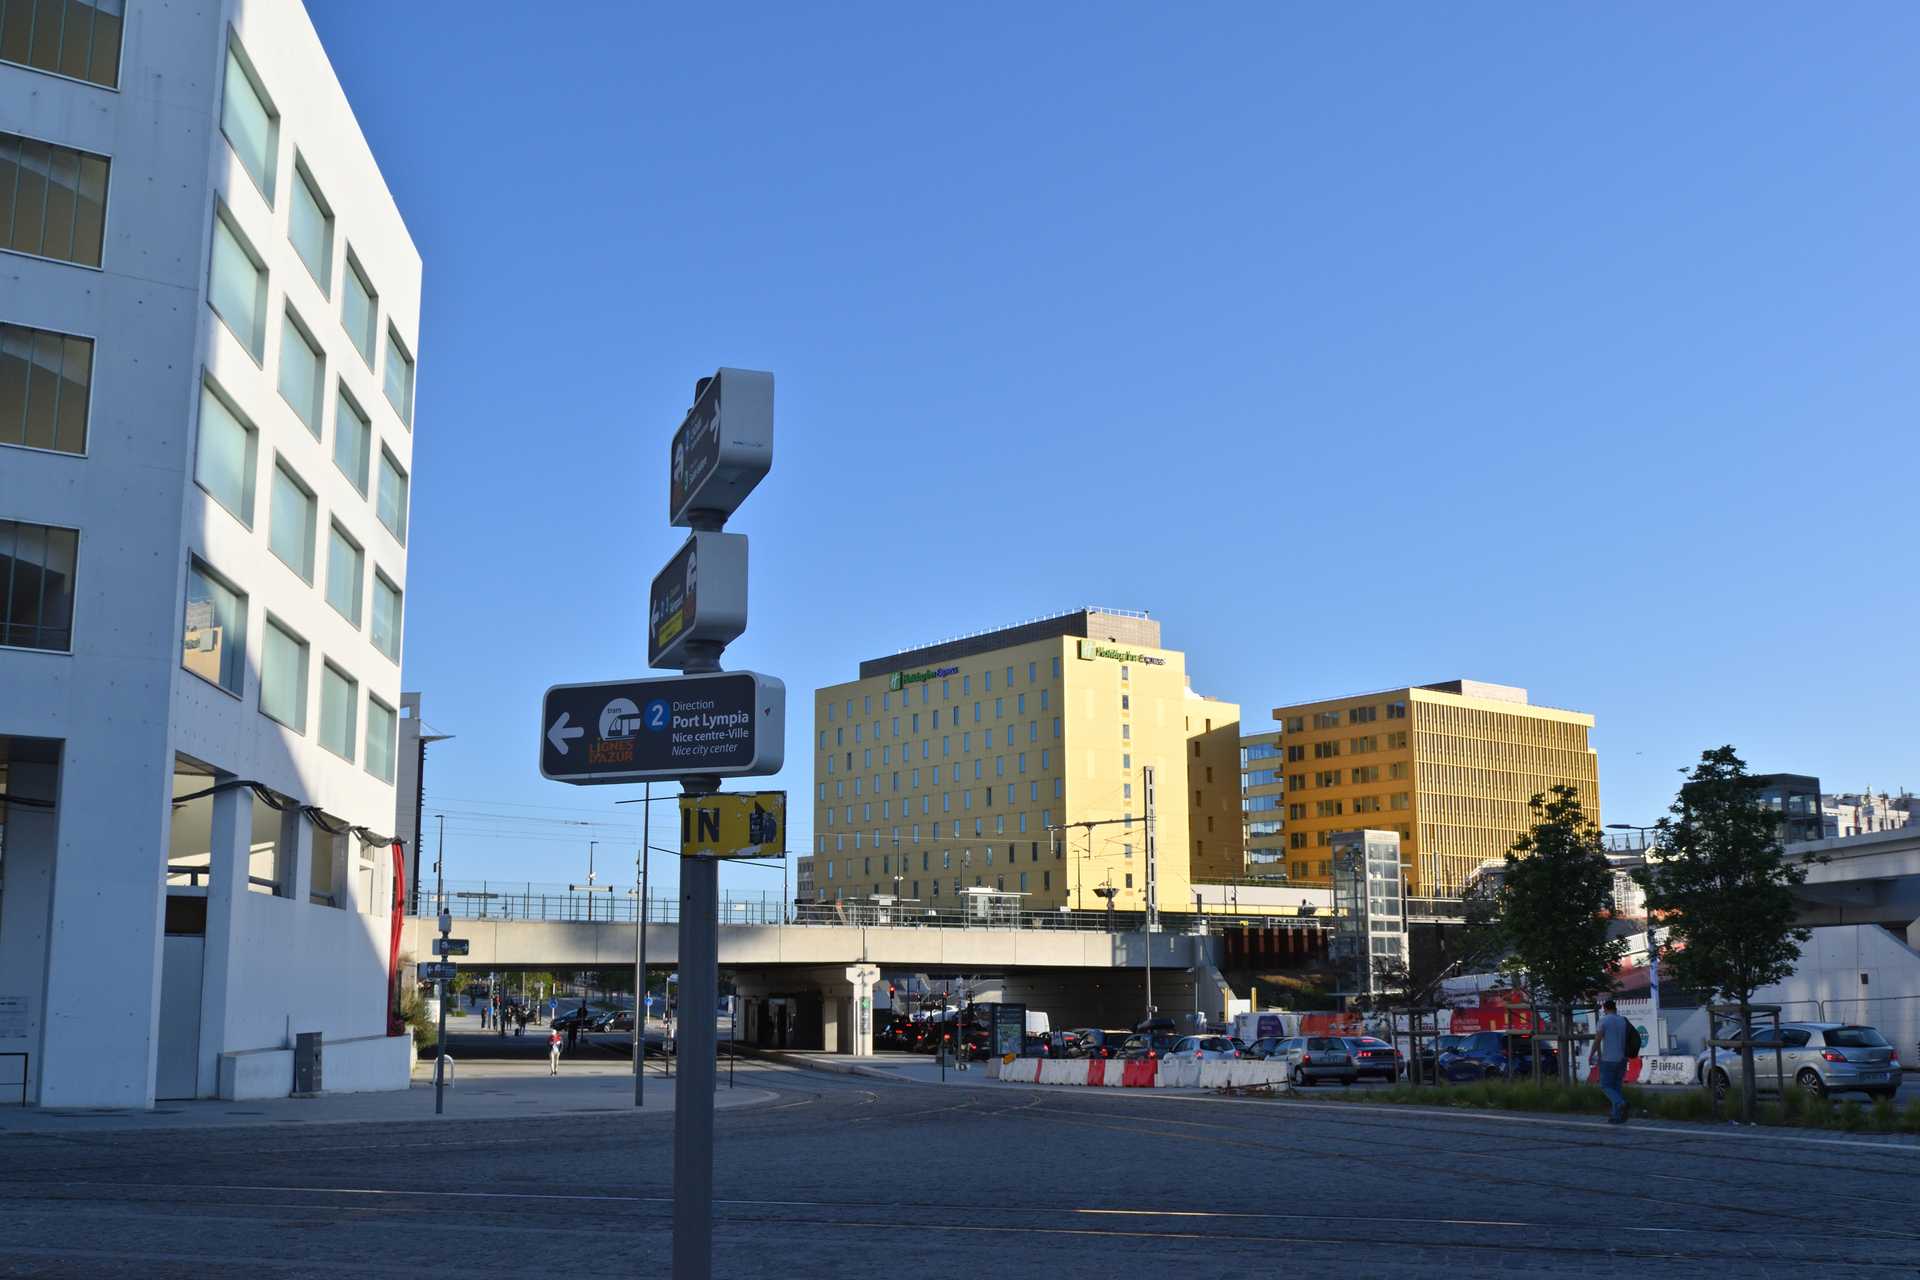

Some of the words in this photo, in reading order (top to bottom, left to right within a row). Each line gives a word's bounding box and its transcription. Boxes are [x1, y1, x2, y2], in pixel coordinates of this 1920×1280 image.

[672, 700, 714, 712] Direction
[651, 704, 664, 726] 2
[672, 715, 700, 729] Port
[702, 710, 749, 729] Lympia
[672, 732, 693, 743] Nice
[694, 728, 749, 741] centre-Ville
[671, 746, 692, 756] Nice
[691, 745, 709, 756] city
[709, 743, 738, 754] center
